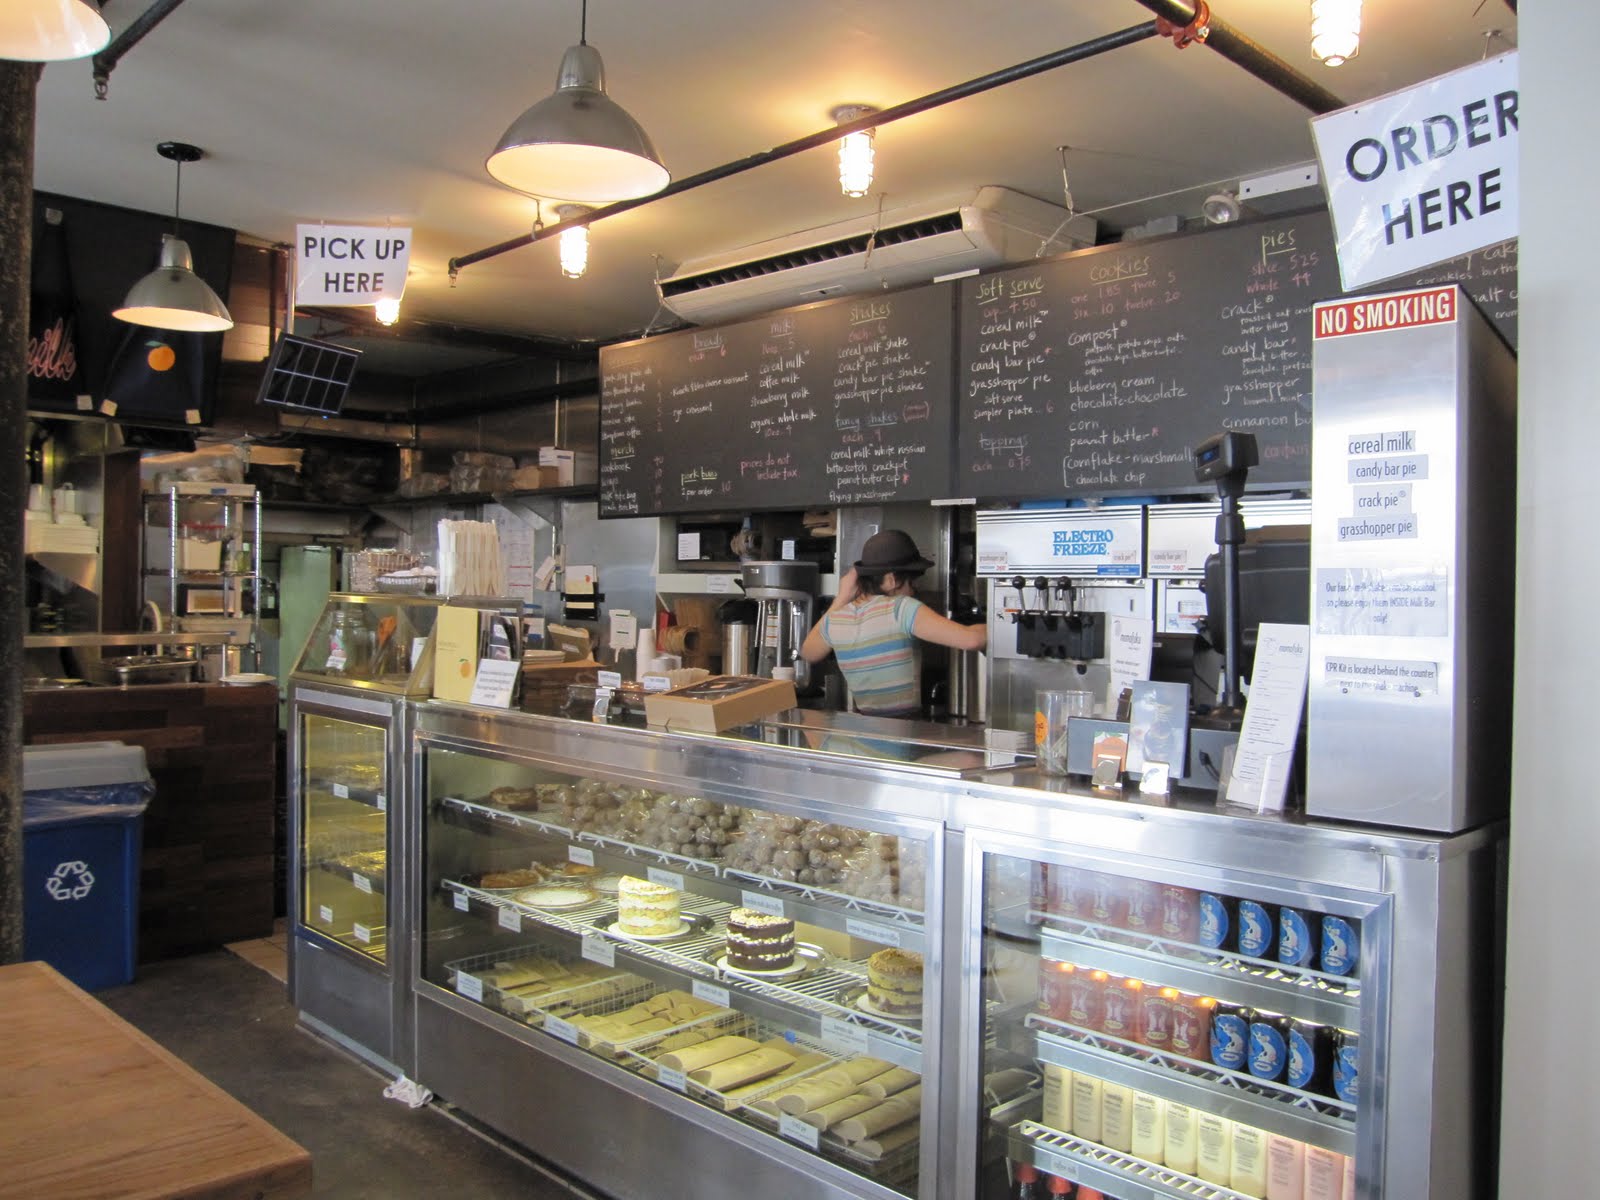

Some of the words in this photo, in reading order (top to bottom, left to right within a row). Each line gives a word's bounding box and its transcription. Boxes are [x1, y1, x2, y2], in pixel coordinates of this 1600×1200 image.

[1346, 90, 1518, 183] ORDER
[1382, 168, 1501, 245] HERE
[304, 236, 365, 260] PICK
[375, 239, 405, 260] UP
[1262, 229, 1296, 267] pies
[1090, 256, 1150, 281] cookies
[1251, 261, 1279, 275] slice
[324, 272, 385, 293] HERE
[976, 278, 1004, 299] soft
[1010, 277, 1045, 295] serve
[1071, 293, 1088, 304] one
[1130, 279, 1157, 293] three
[1168, 271, 1177, 284] 5
[1246, 279, 1280, 294] whole
[850, 302, 891, 321] shakes
[1073, 308, 1089, 320] six
[1101, 302, 1115, 315] 10
[1164, 290, 1181, 304] 20
[1321, 307, 1347, 335] NO
[1353, 292, 1450, 331] SMOKING
[1240, 312, 1271, 325] roasted
[1276, 307, 1290, 318] oat
[981, 318, 1012, 334] cereal
[1266, 320, 1289, 333] filling
[839, 344, 861, 358] cereal
[884, 336, 908, 351] shake
[980, 339, 1011, 353] crack
[1118, 338, 1142, 354] potato
[1222, 340, 1257, 358] candy
[1264, 337, 1289, 349] bar
[760, 356, 783, 374] cereal
[786, 353, 806, 368] milk
[864, 361, 879, 374] pie
[881, 352, 910, 365] shake
[971, 357, 1000, 374] candy
[1004, 356, 1023, 367] bar
[1027, 355, 1046, 371] pie
[759, 375, 779, 388] coffee
[781, 373, 800, 384] milk
[833, 374, 858, 390] candy
[862, 373, 878, 383] bar
[881, 373, 894, 386] pie
[898, 364, 927, 379] shake
[969, 376, 1029, 397] grasshopper
[1033, 374, 1051, 390] pie
[1069, 380, 1118, 397] blueberry
[1121, 376, 1155, 388] cream
[750, 393, 788, 407] strawberry
[791, 386, 811, 399] milk
[835, 388, 880, 408] grasshopper
[880, 387, 893, 402] pie
[896, 382, 925, 393] shake
[983, 392, 1001, 404] soft
[1001, 394, 1024, 404] serve
[1221, 378, 1300, 405] grasshopper
[778, 408, 799, 423] whole
[801, 408, 817, 421] milk
[835, 413, 860, 432] fancy
[973, 409, 1002, 421] sampler
[1221, 414, 1289, 429] cinnamon
[1068, 420, 1100, 431] corn
[979, 432, 1029, 456] toppings
[1070, 429, 1108, 452] peanut
[1112, 426, 1150, 445] butter
[1348, 433, 1384, 454] cereal
[1387, 431, 1413, 452] milk
[610, 443, 635, 457] merch
[831, 446, 852, 460] cereal
[874, 445, 895, 457] white
[898, 446, 926, 455] russian
[601, 463, 632, 473] cookbook
[740, 459, 763, 477] prices
[765, 452, 775, 466] do
[777, 452, 790, 465] not
[757, 467, 781, 480] include
[783, 467, 798, 481] tax
[1355, 461, 1383, 479] candy
[1384, 461, 1400, 476] bar
[1402, 461, 1417, 478] pie
[681, 469, 699, 486] pork
[837, 474, 861, 489] peanut
[861, 473, 885, 485] butter
[886, 475, 901, 488] cup
[1075, 468, 1117, 485] chocolate
[1124, 472, 1147, 487] chip
[686, 490, 697, 501] per
[697, 486, 713, 497] order
[829, 490, 852, 503] flying
[855, 491, 897, 503] grasshopper
[1358, 491, 1382, 507] crack
[1053, 529, 1114, 543] ELECTRO
[1340, 520, 1396, 539] grasshopper
[1398, 520, 1413, 536] pie
[1053, 543, 1107, 556] FREEZE
[1335, 598, 1353, 609] please
[1424, 597, 1436, 608] Bar
[1326, 662, 1337, 672] CPR
[1339, 663, 1347, 673] Kit
[1348, 664, 1352, 673] is
[1354, 664, 1376, 675] located
[1377, 665, 1399, 677] behind
[1400, 667, 1410, 677] the
[1411, 669, 1434, 679] counter
